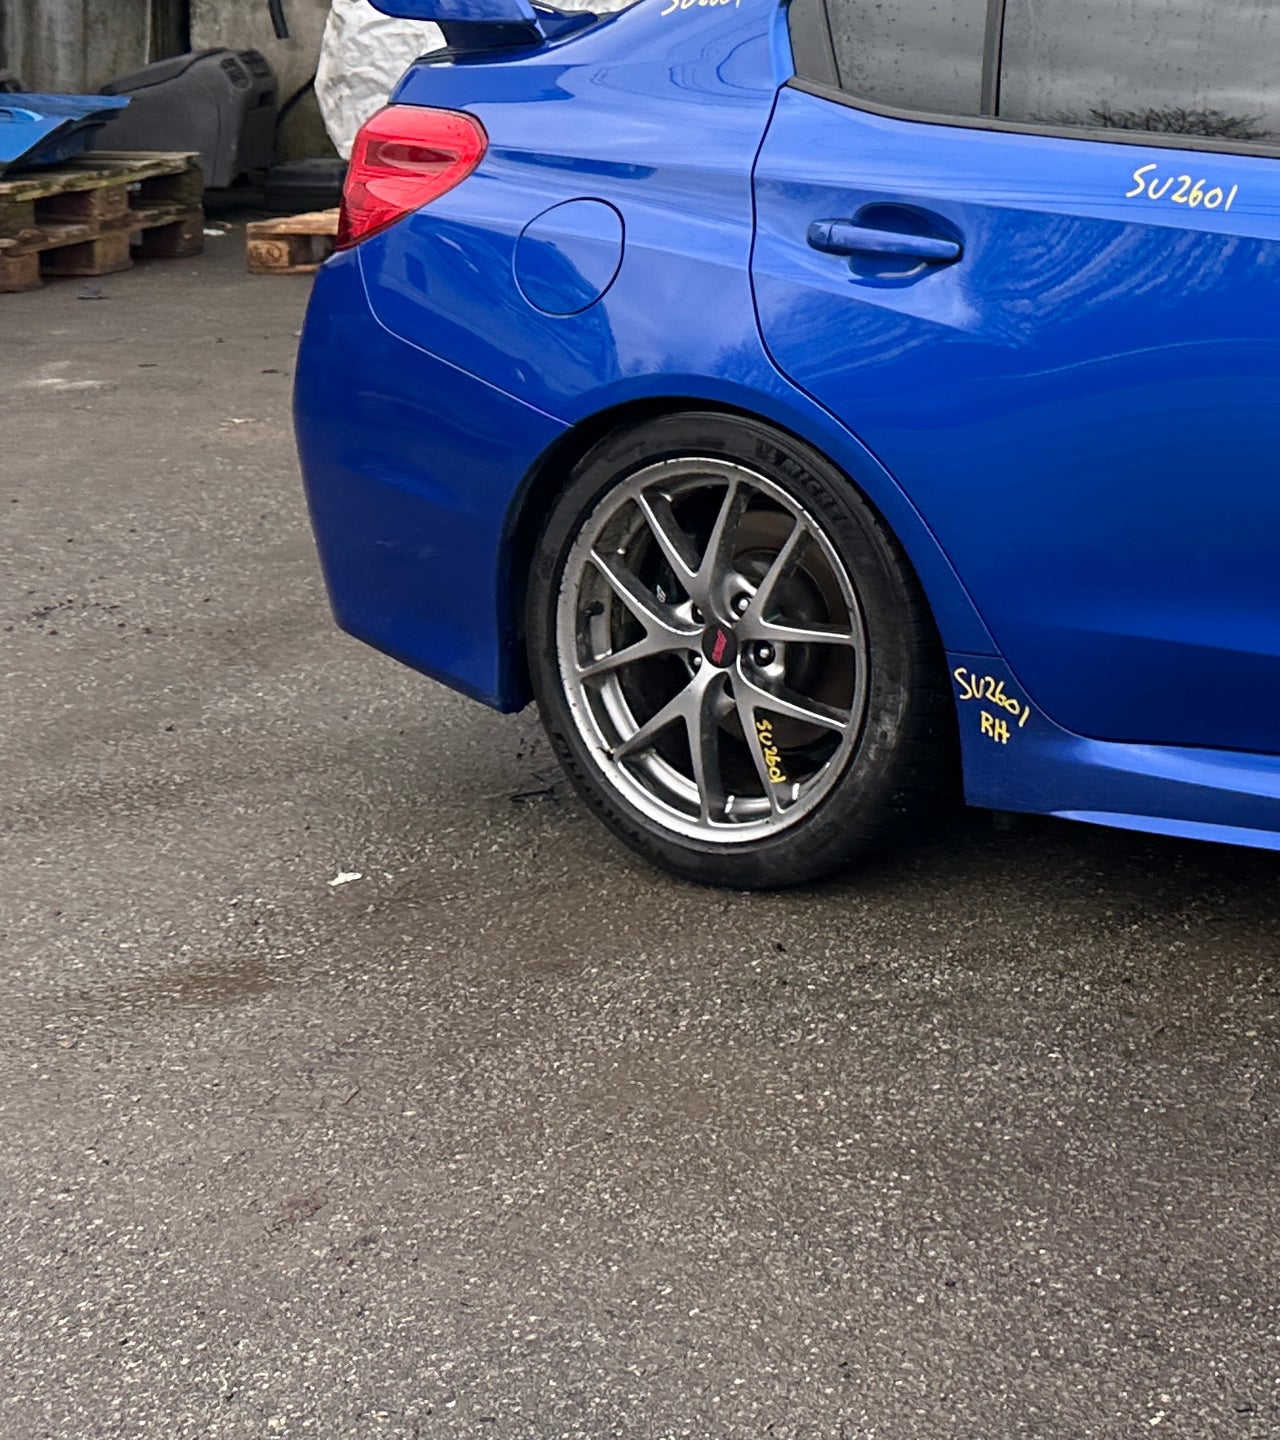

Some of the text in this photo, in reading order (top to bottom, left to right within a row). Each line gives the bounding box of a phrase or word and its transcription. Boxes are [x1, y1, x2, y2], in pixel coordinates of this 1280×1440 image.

[1125, 163, 1238, 212] SU2601
[953, 666, 1031, 728] SU2601
[980, 710, 1011, 745] RH
